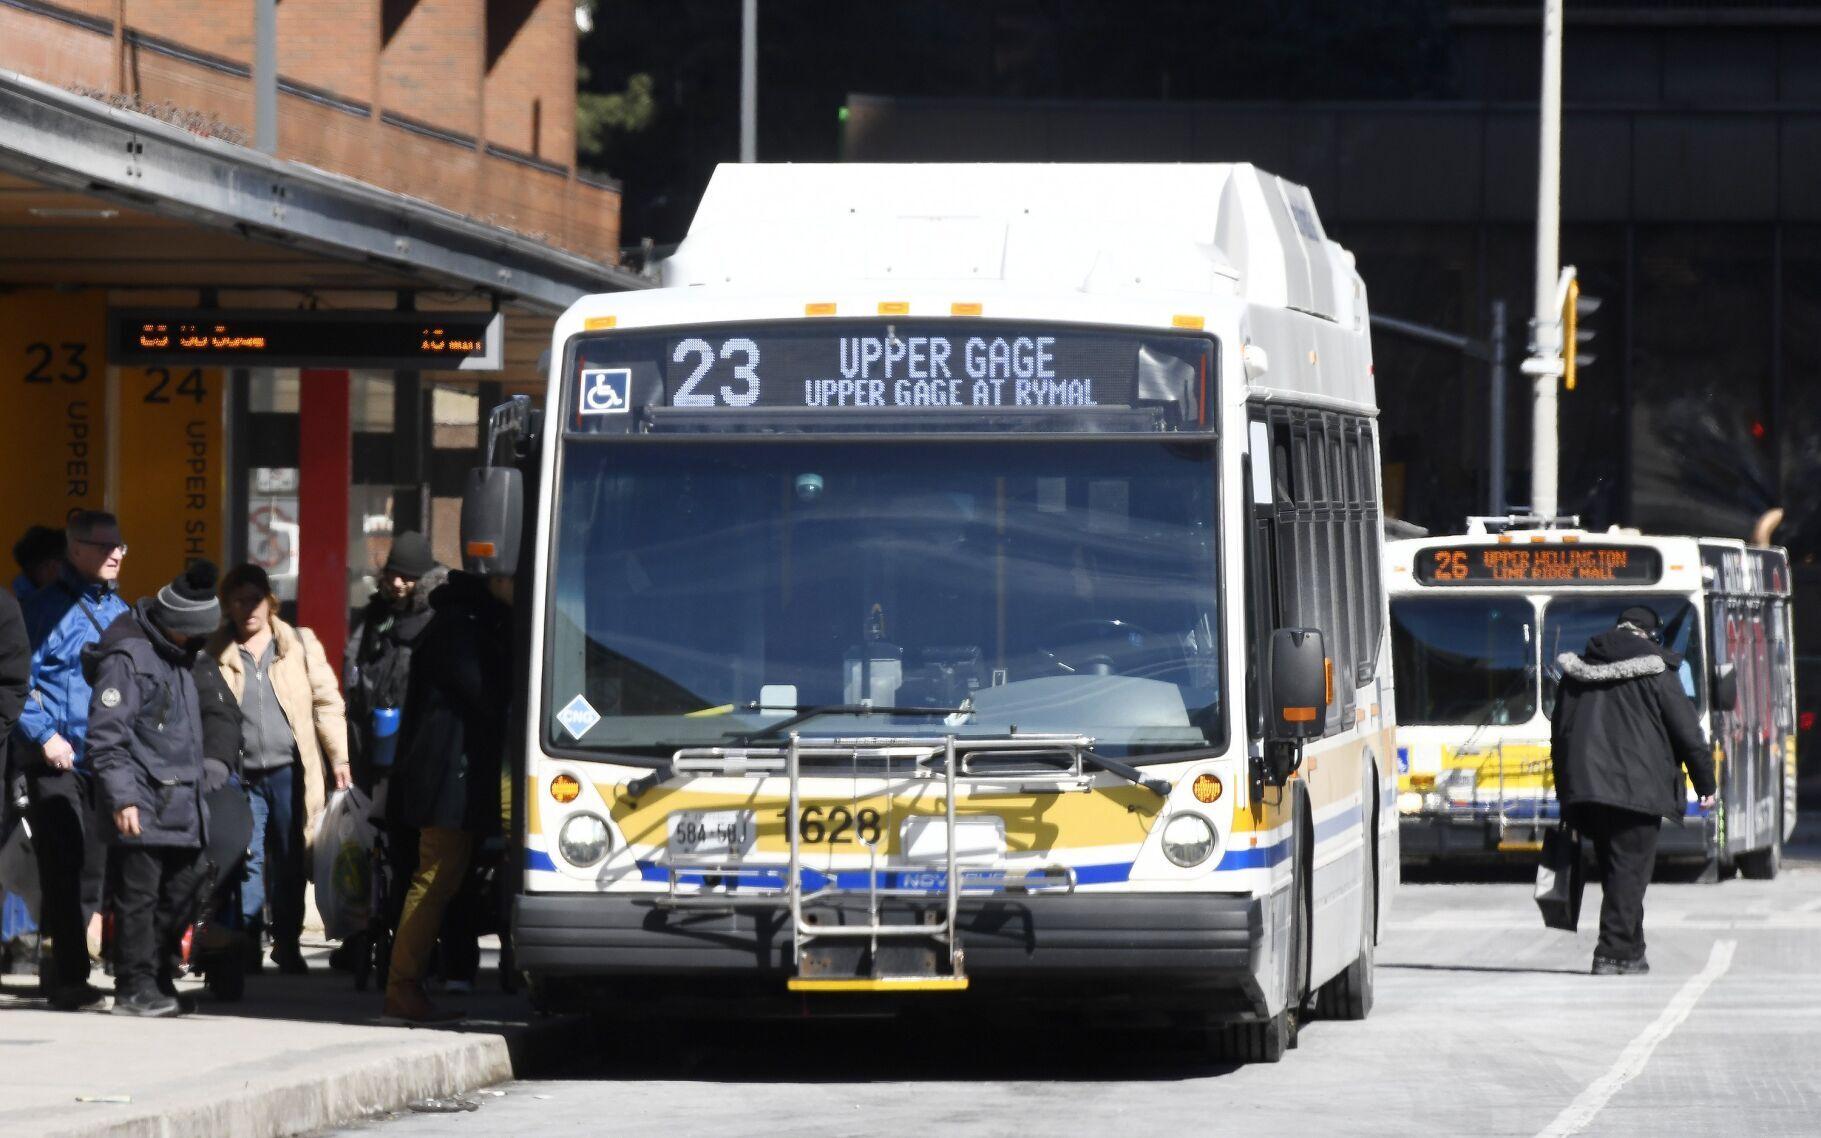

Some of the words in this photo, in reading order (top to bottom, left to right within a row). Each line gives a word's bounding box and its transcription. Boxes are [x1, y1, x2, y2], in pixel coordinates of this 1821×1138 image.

[25, 343, 88, 383] 23
[673, 338, 761, 407] 23
[840, 337, 951, 379] UPPER
[965, 337, 1055, 379] GAGE
[144, 367, 207, 404] 24
[805, 379, 886, 407] UPPER
[894, 379, 963, 407] GAGE
[972, 379, 1005, 407] AT
[1015, 379, 1098, 407] RYMAL
[67, 401, 89, 497] UPPER
[186, 421, 207, 511] UPPER
[1434, 551, 1469, 581] 26
[777, 805, 880, 845] 1628
